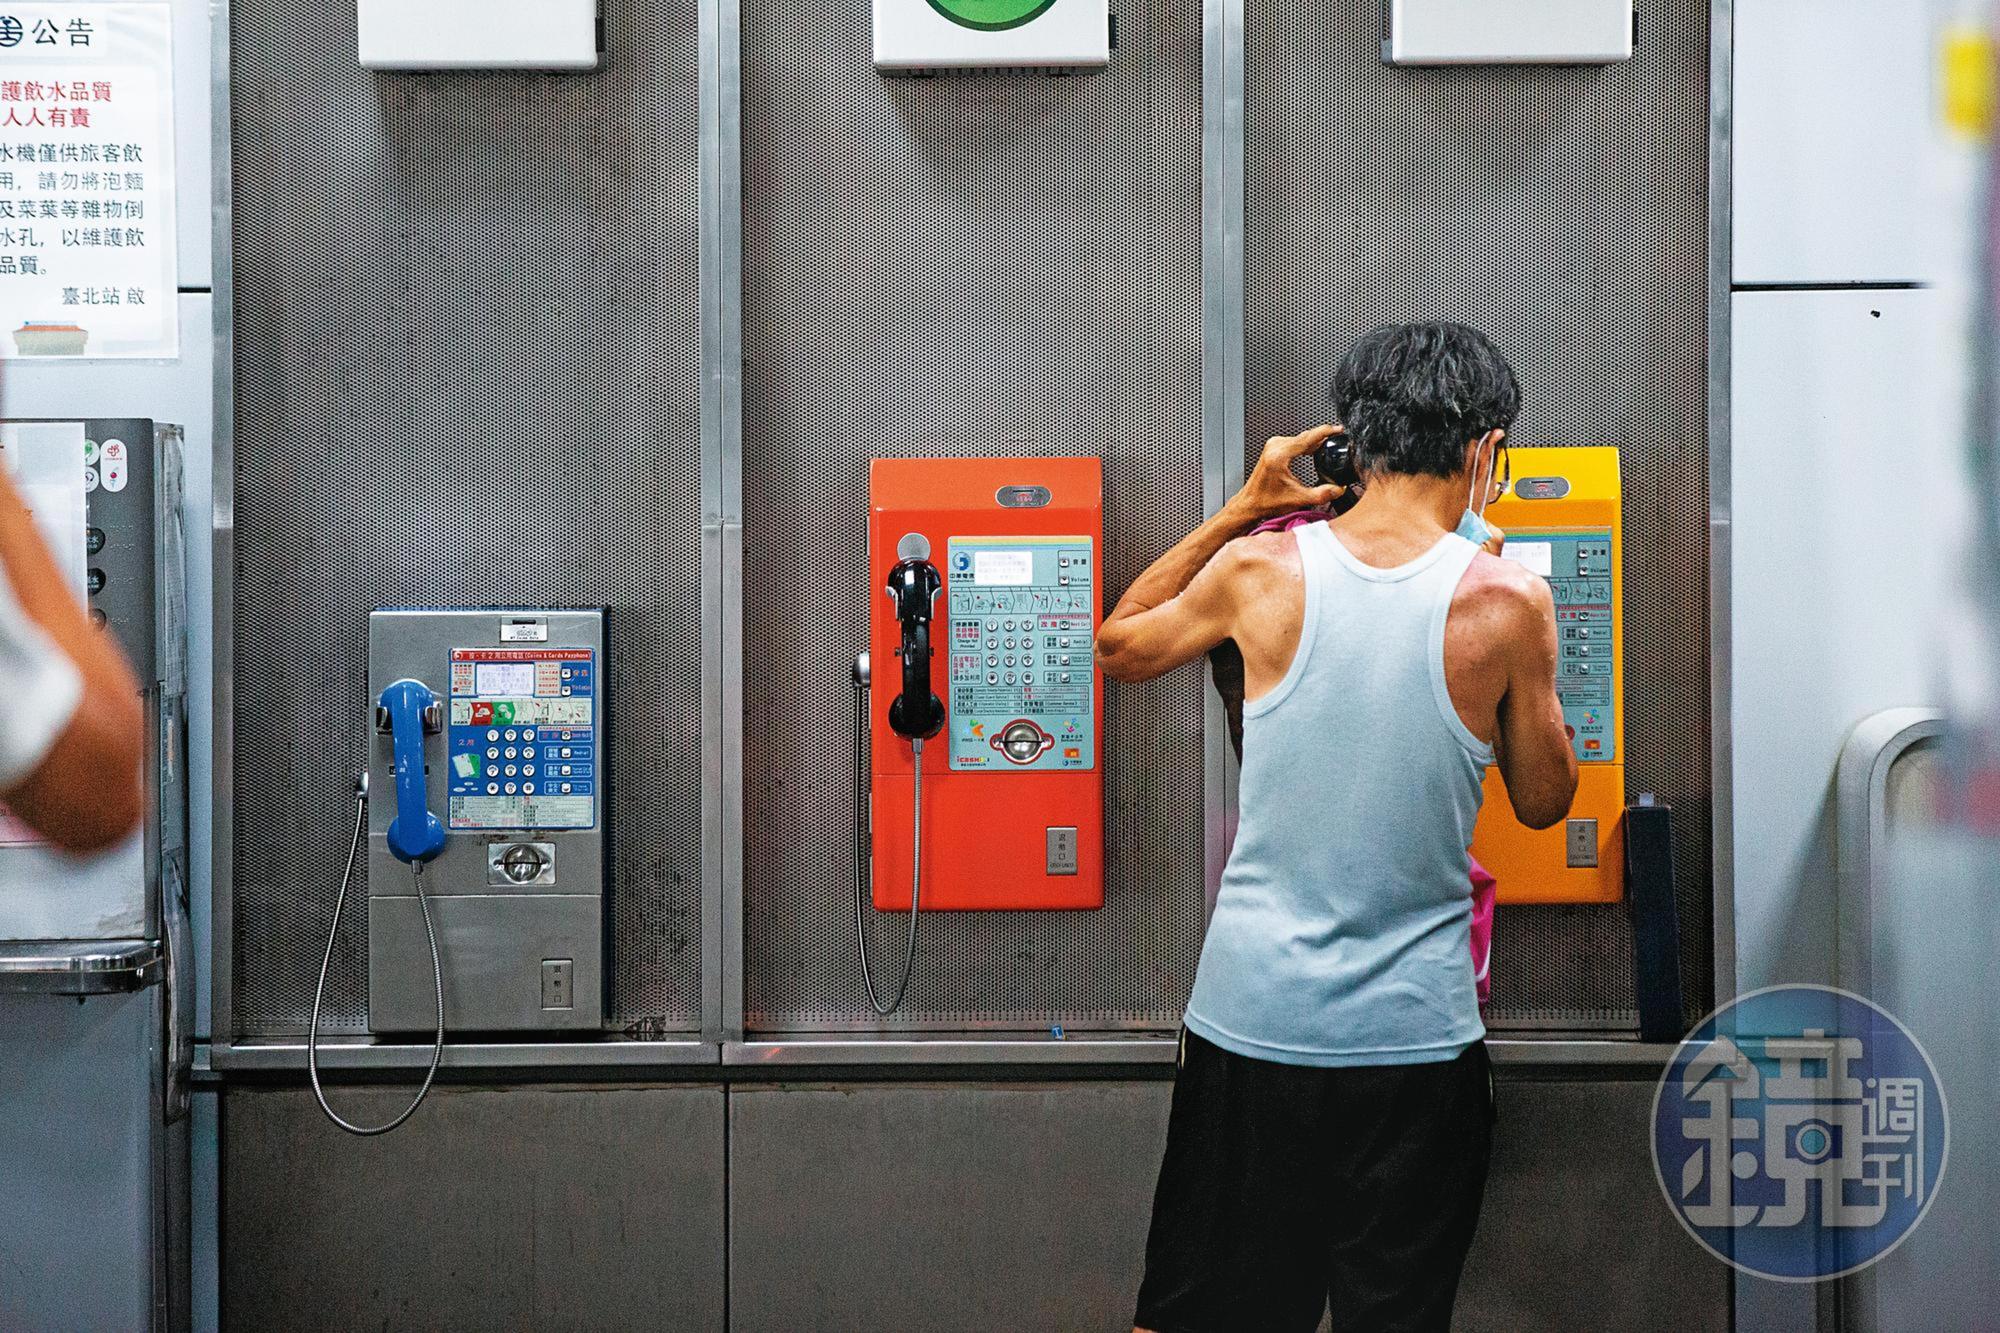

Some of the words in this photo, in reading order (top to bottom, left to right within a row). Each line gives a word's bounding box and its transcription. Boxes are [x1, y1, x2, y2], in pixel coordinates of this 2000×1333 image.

[31, 18, 94, 46] 公告
[1, 81, 112, 102] 護飲水品質
[3, 107, 90, 128] 人人有責
[0, 256, 47, 275] 品質。
